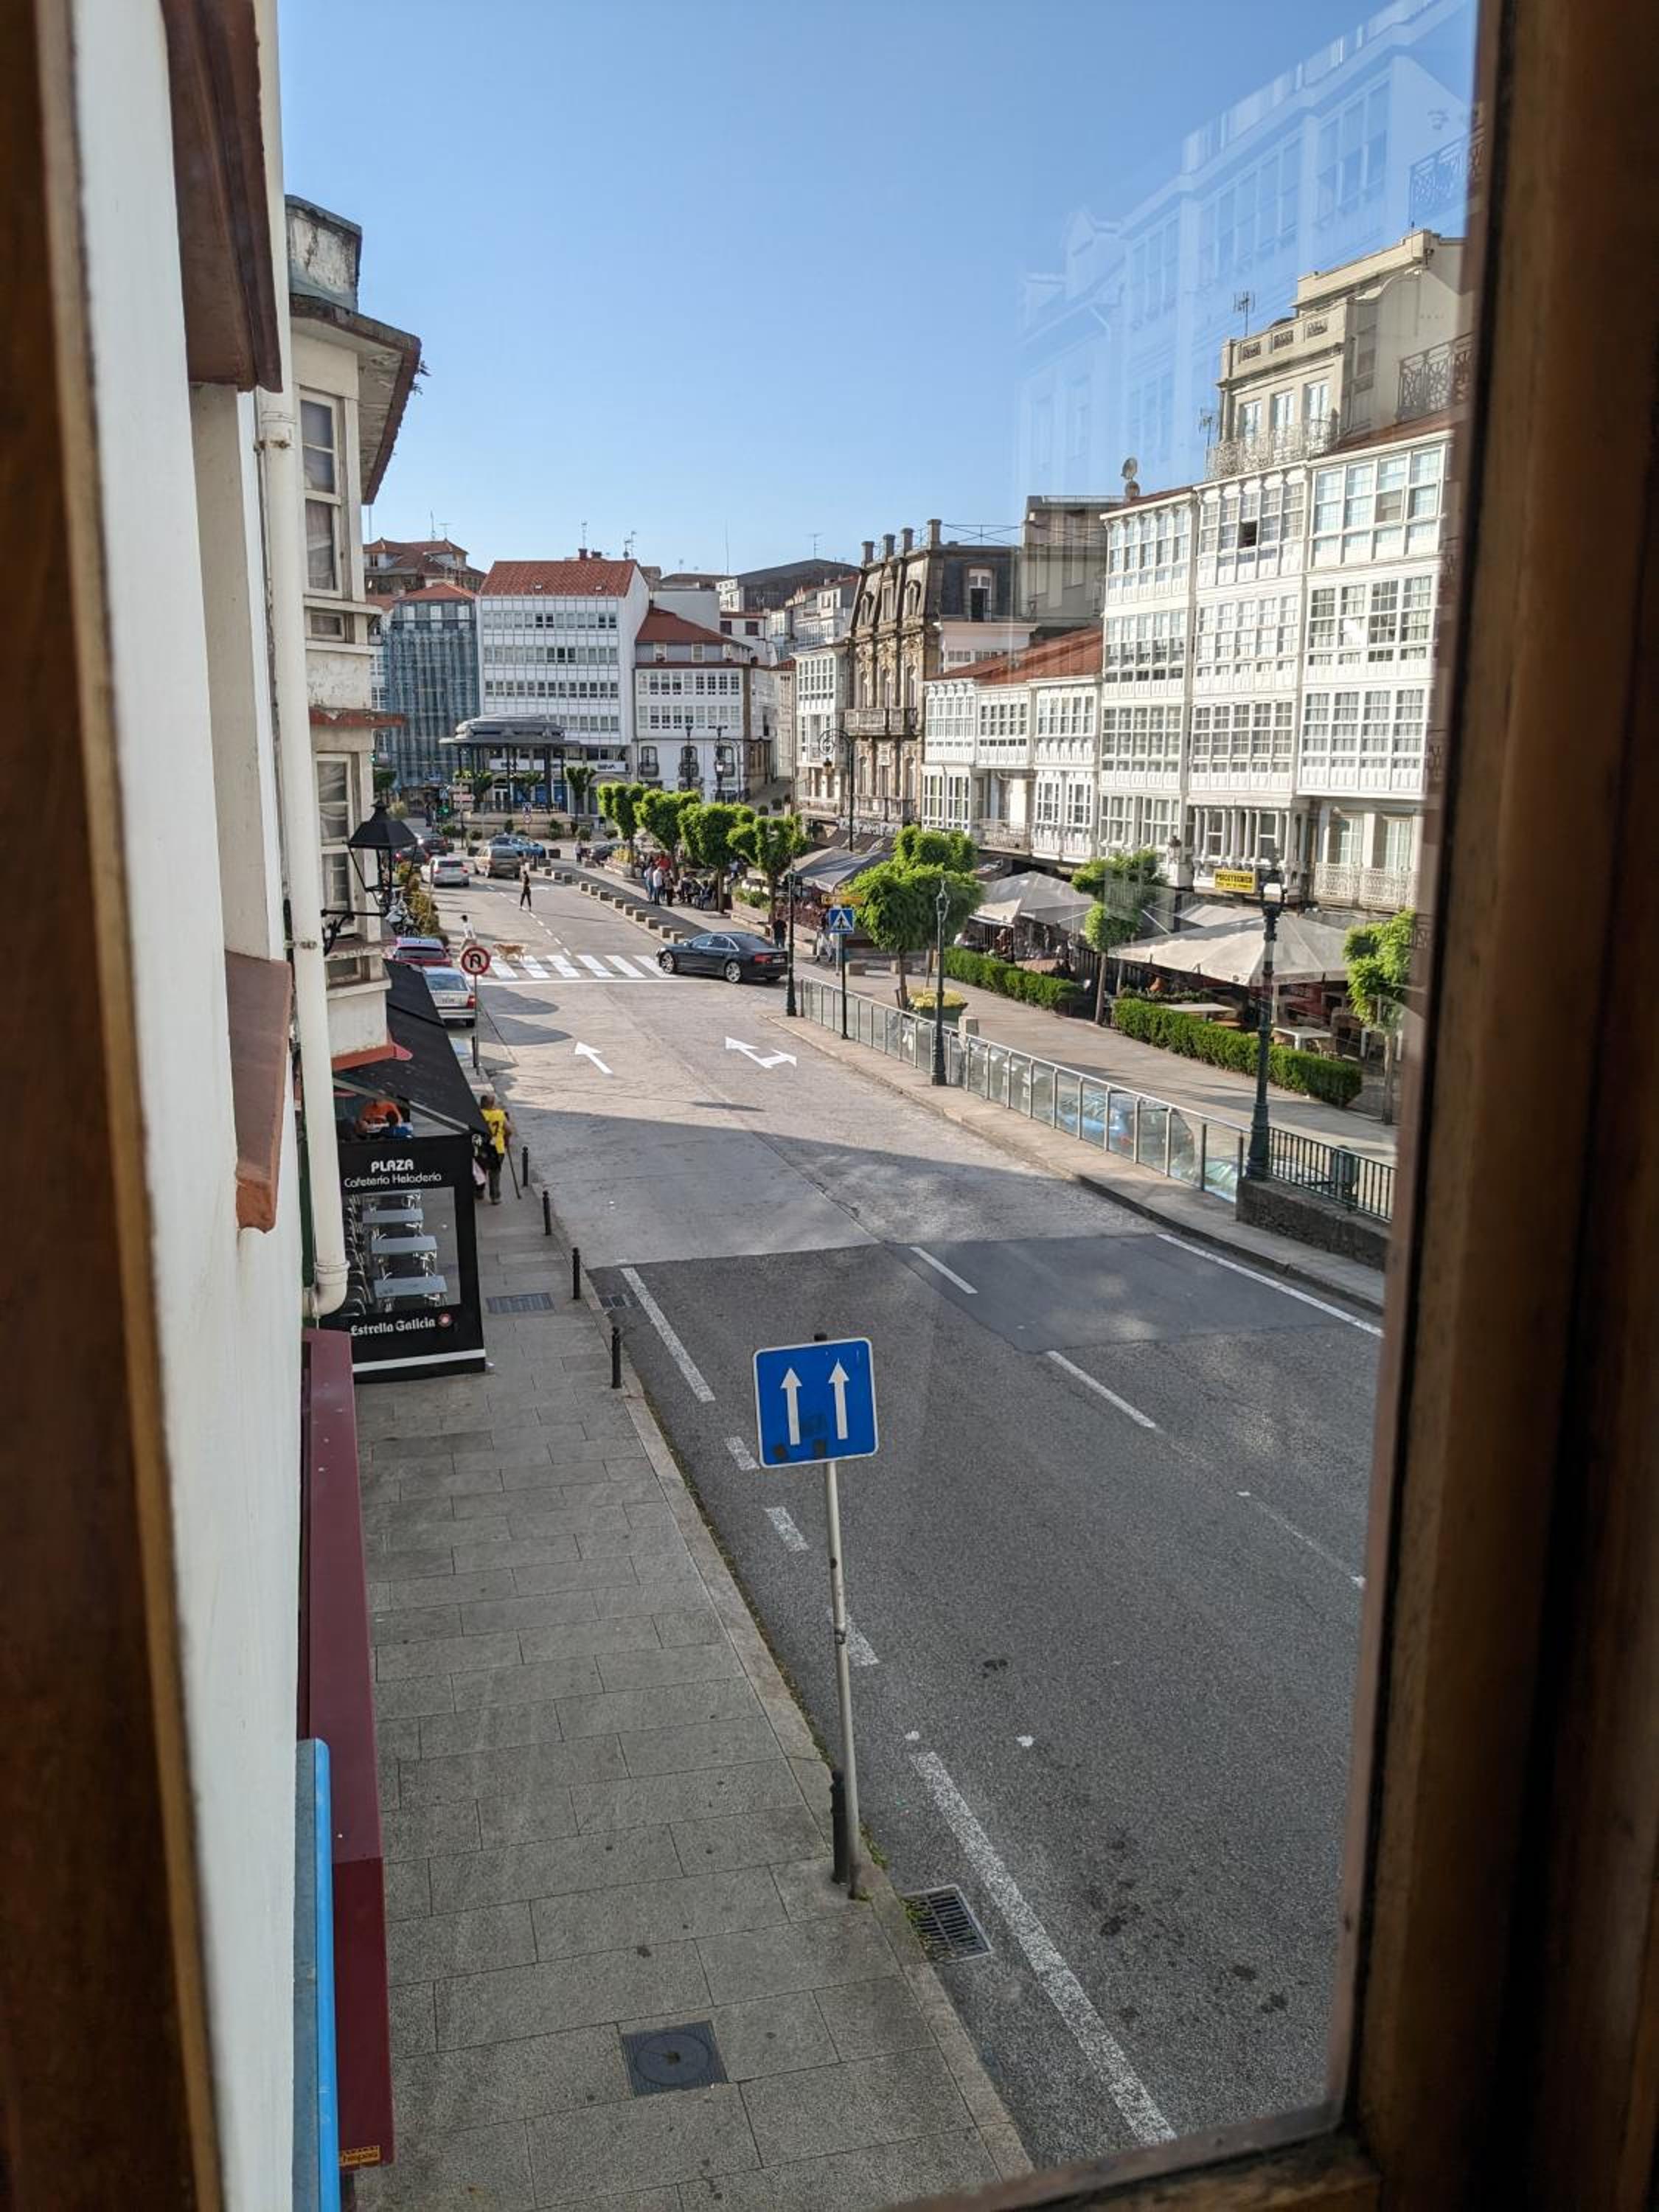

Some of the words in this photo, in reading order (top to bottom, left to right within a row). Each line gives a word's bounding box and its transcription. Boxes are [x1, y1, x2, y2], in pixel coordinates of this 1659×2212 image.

[371, 1158, 414, 1173] PLAZA
[350, 1322, 394, 1336] Estrella
[395, 1317, 436, 1331] Galicia
